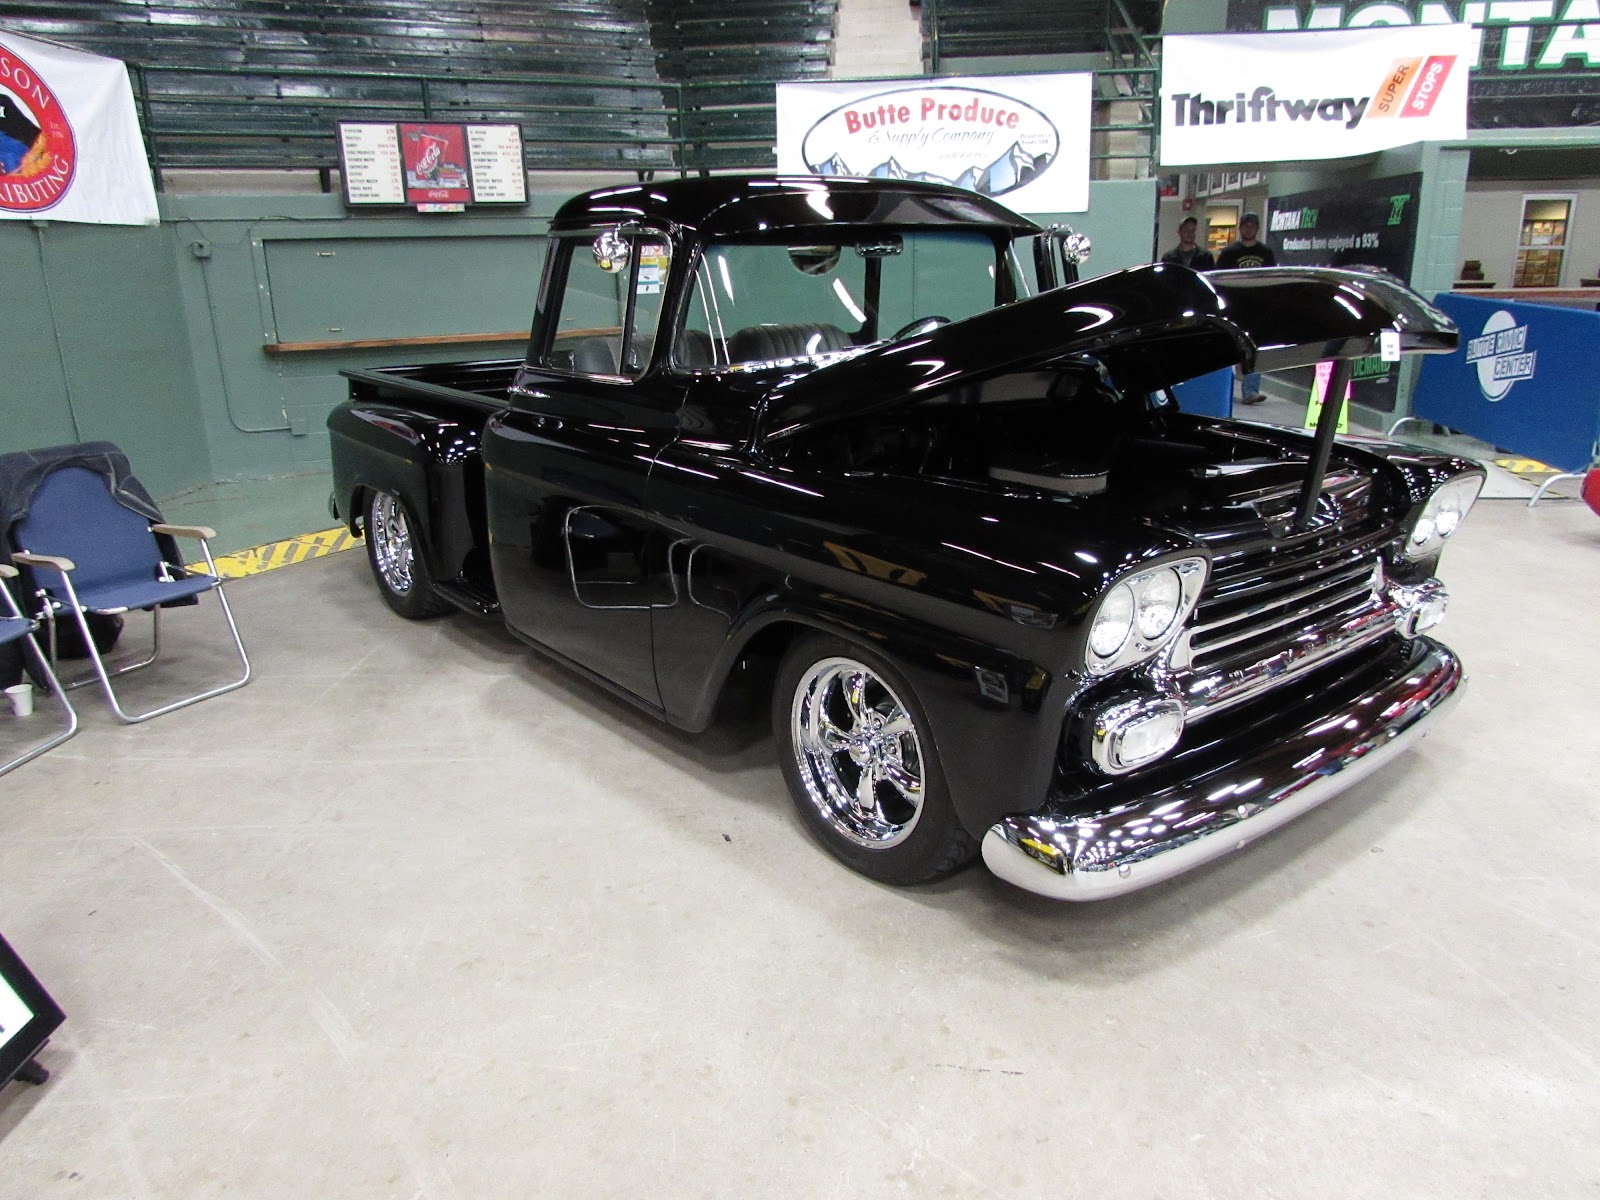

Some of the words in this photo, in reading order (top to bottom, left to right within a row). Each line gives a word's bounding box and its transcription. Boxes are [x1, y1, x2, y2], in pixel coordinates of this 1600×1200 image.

[1378, 64, 1410, 112] SUPER
[1412, 61, 1443, 111] STOPS
[844, 104, 910, 134] Butte
[921, 97, 1019, 129] Produce
[1171, 86, 1370, 129] Thriftway
[887, 127, 929, 149] Supply
[932, 127, 995, 146] Company
[1283, 238, 1311, 250] Graduates
[1312, 237, 1327, 249] have
[1328, 234, 1355, 252] enjoyed
[1361, 233, 1379, 248] 93%
[1494, 352, 1534, 379] CENTER
